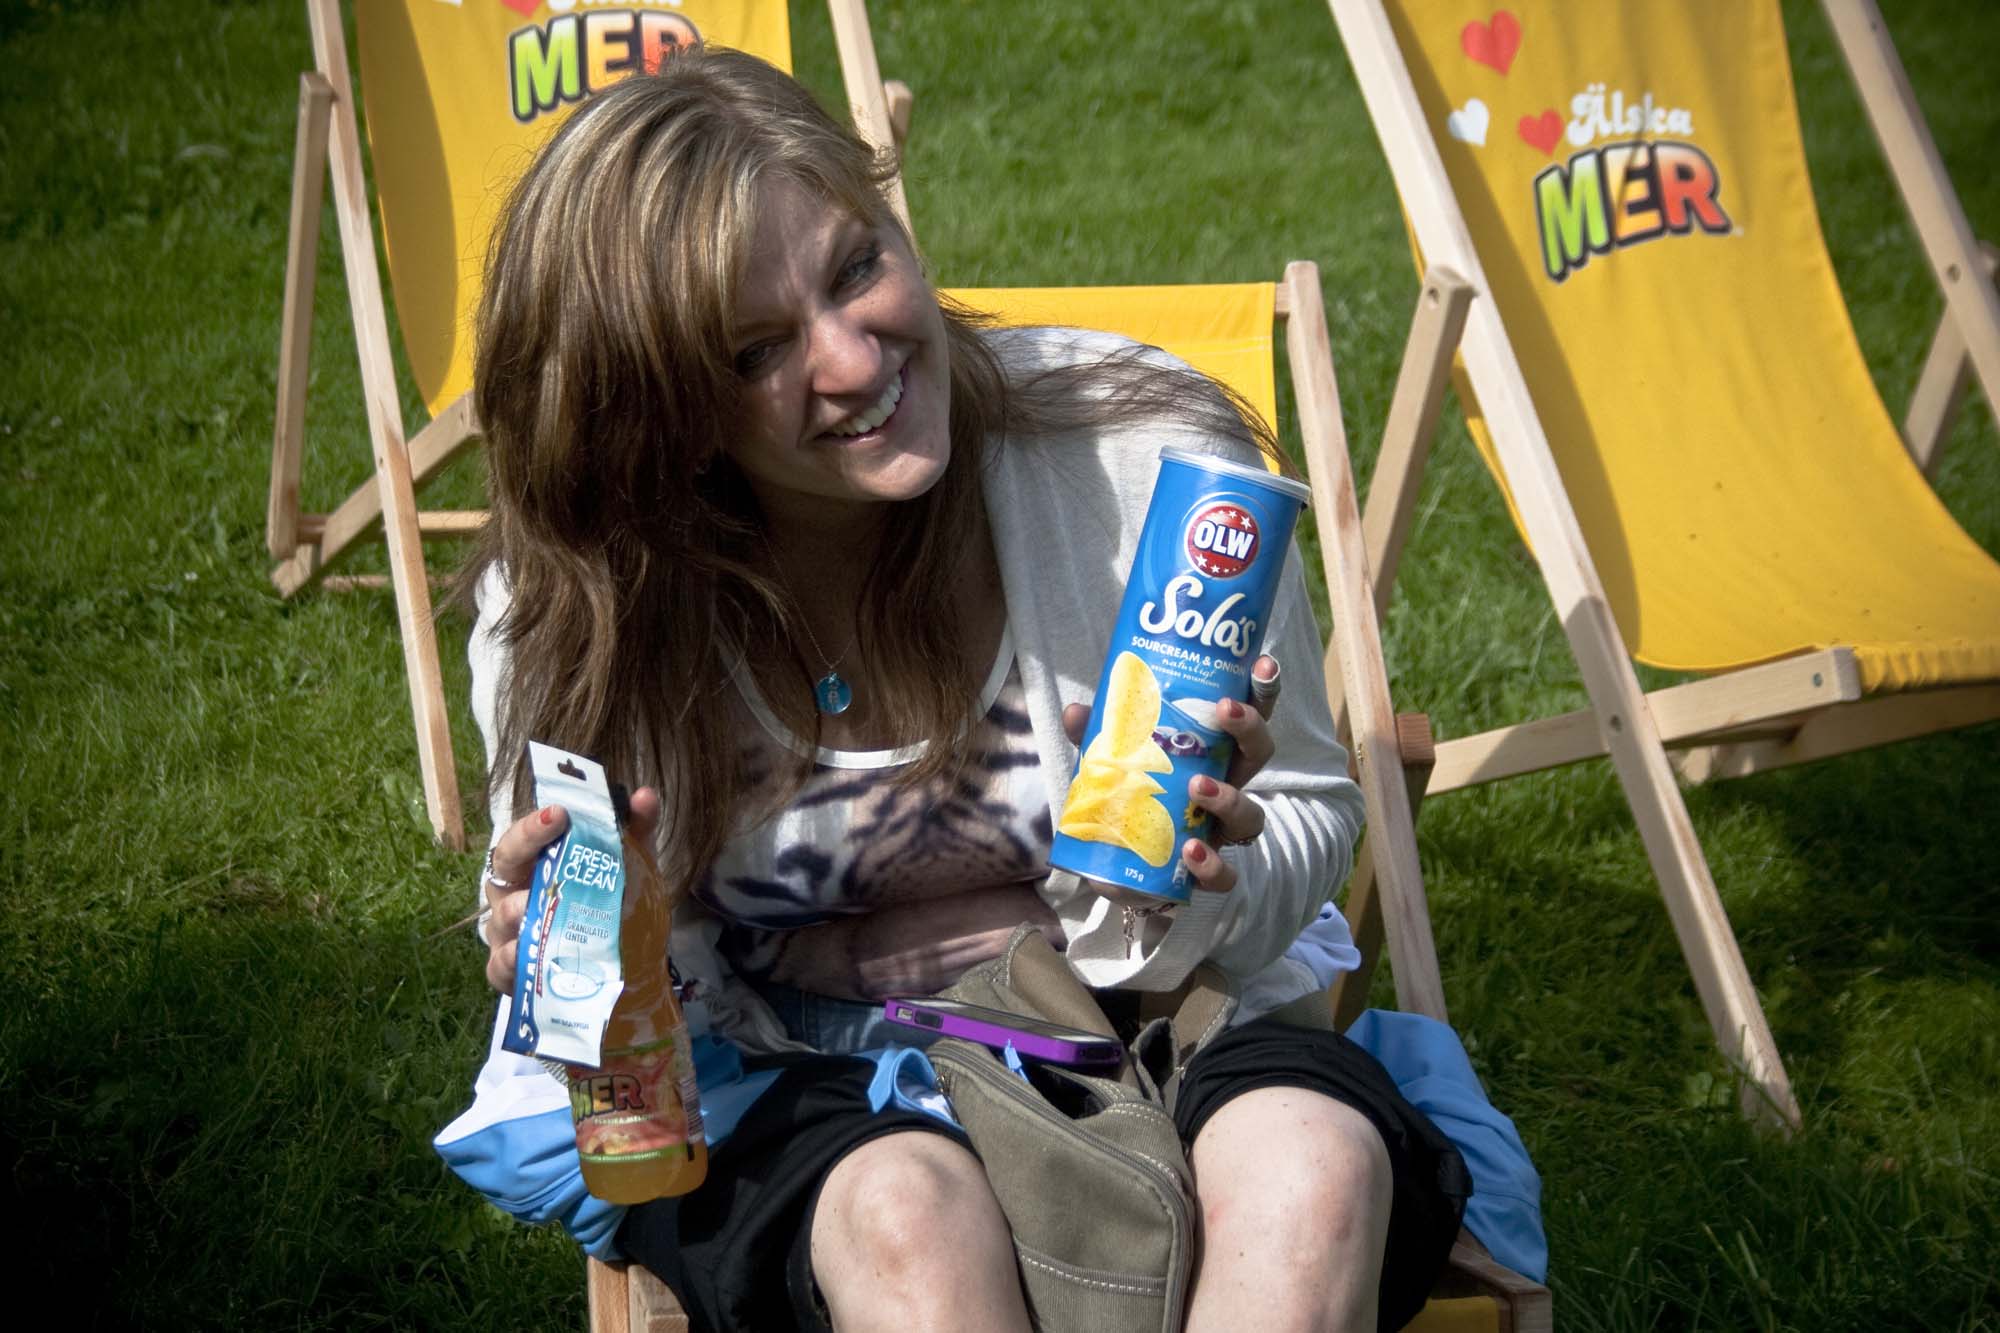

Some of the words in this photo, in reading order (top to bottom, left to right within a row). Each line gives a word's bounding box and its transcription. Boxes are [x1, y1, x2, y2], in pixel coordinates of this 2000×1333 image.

[1566, 82, 1694, 147] Älska
[1533, 140, 1733, 284] MER
[1193, 520, 1256, 561] OLW
[1139, 575, 1257, 657] Solo's
[1131, 636, 1201, 663] SOURCREAM
[1202, 656, 1211, 667] &
[1214, 659, 1246, 677] ONION
[563, 861, 617, 893] CLEAN
[569, 844, 620, 875] FRESH
[564, 930, 589, 945] CENTER
[569, 1073, 645, 1125] MER
